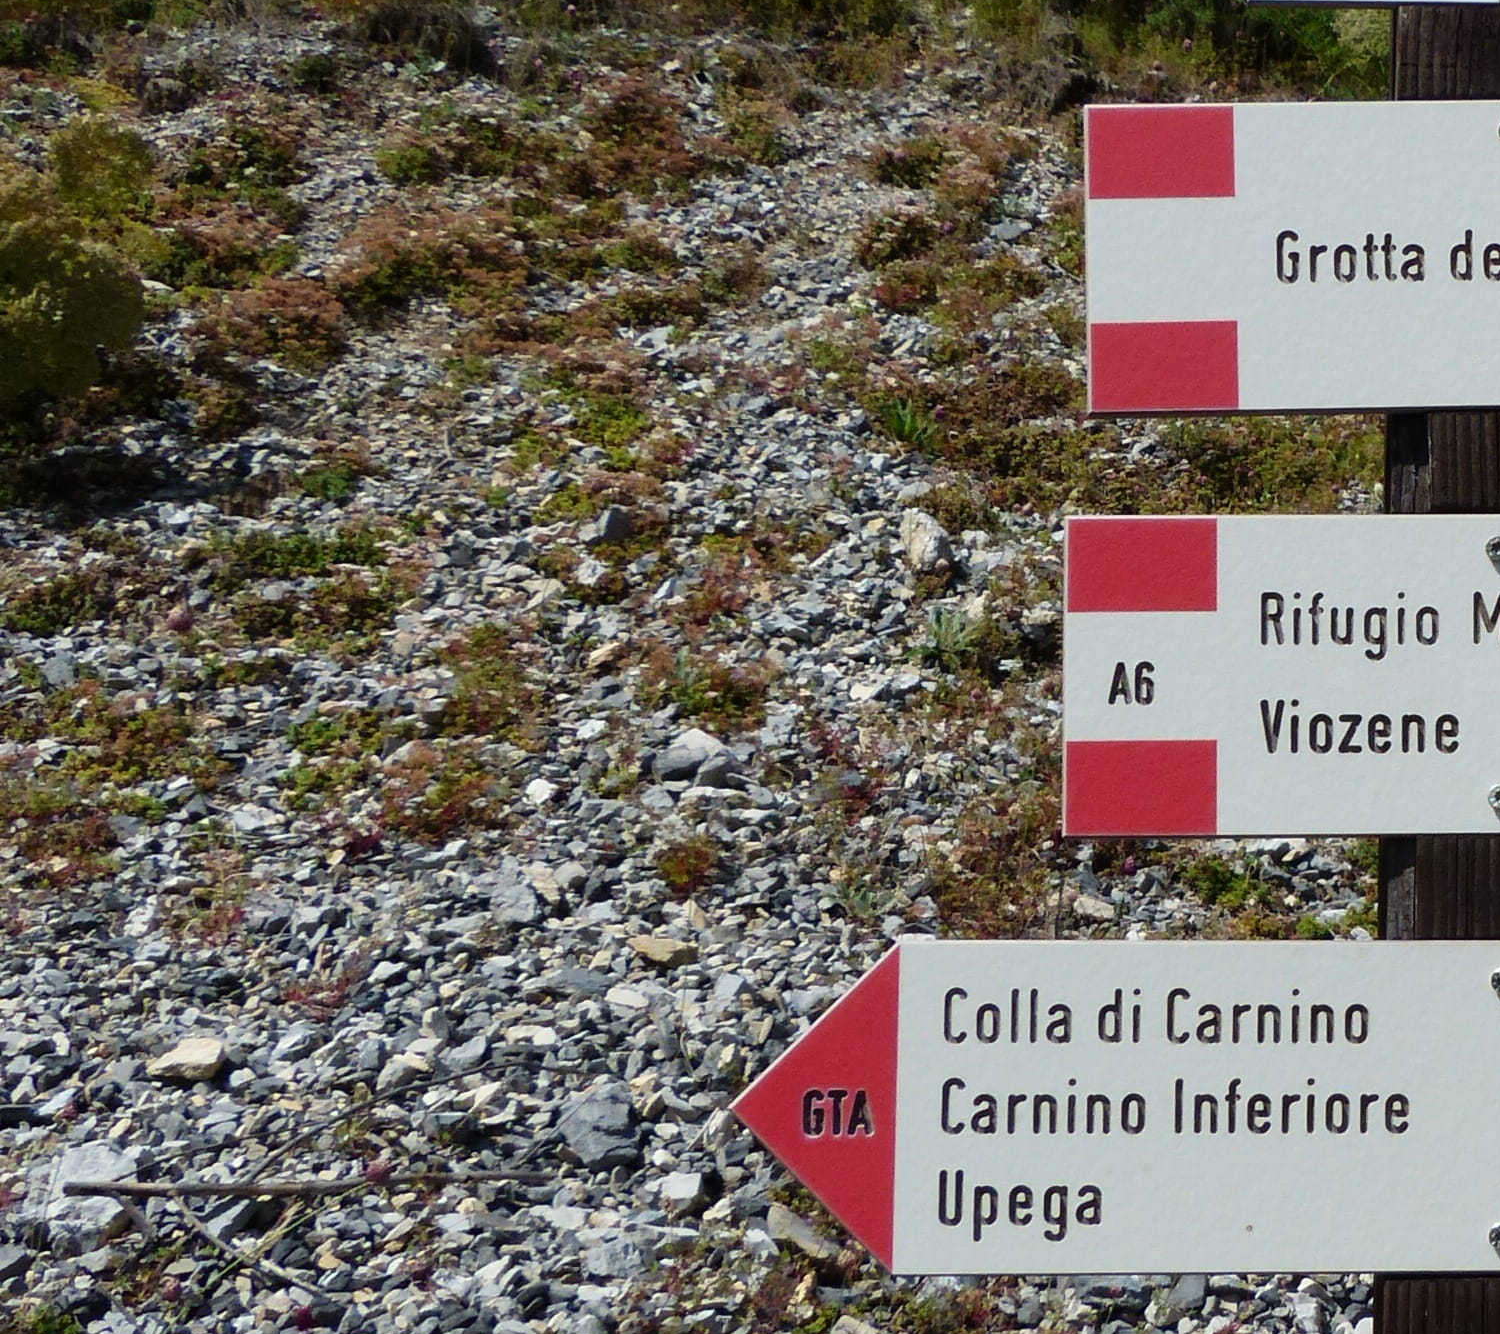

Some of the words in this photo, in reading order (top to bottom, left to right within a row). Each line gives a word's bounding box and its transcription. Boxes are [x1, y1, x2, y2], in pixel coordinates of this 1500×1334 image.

[1276, 229, 1425, 284] Grotta
[1260, 591, 1439, 661] Rifugio
[1107, 660, 1155, 706] A6
[1259, 698, 1460, 754] Viozene
[943, 987, 1072, 1044] Colla
[1097, 988, 1141, 1044] di
[1166, 987, 1369, 1045] Carnino
[802, 1088, 875, 1138] GTA
[940, 1077, 1146, 1135] Carnino
[1174, 1077, 1410, 1135] Inferiore
[938, 1169, 1102, 1242] Upega
